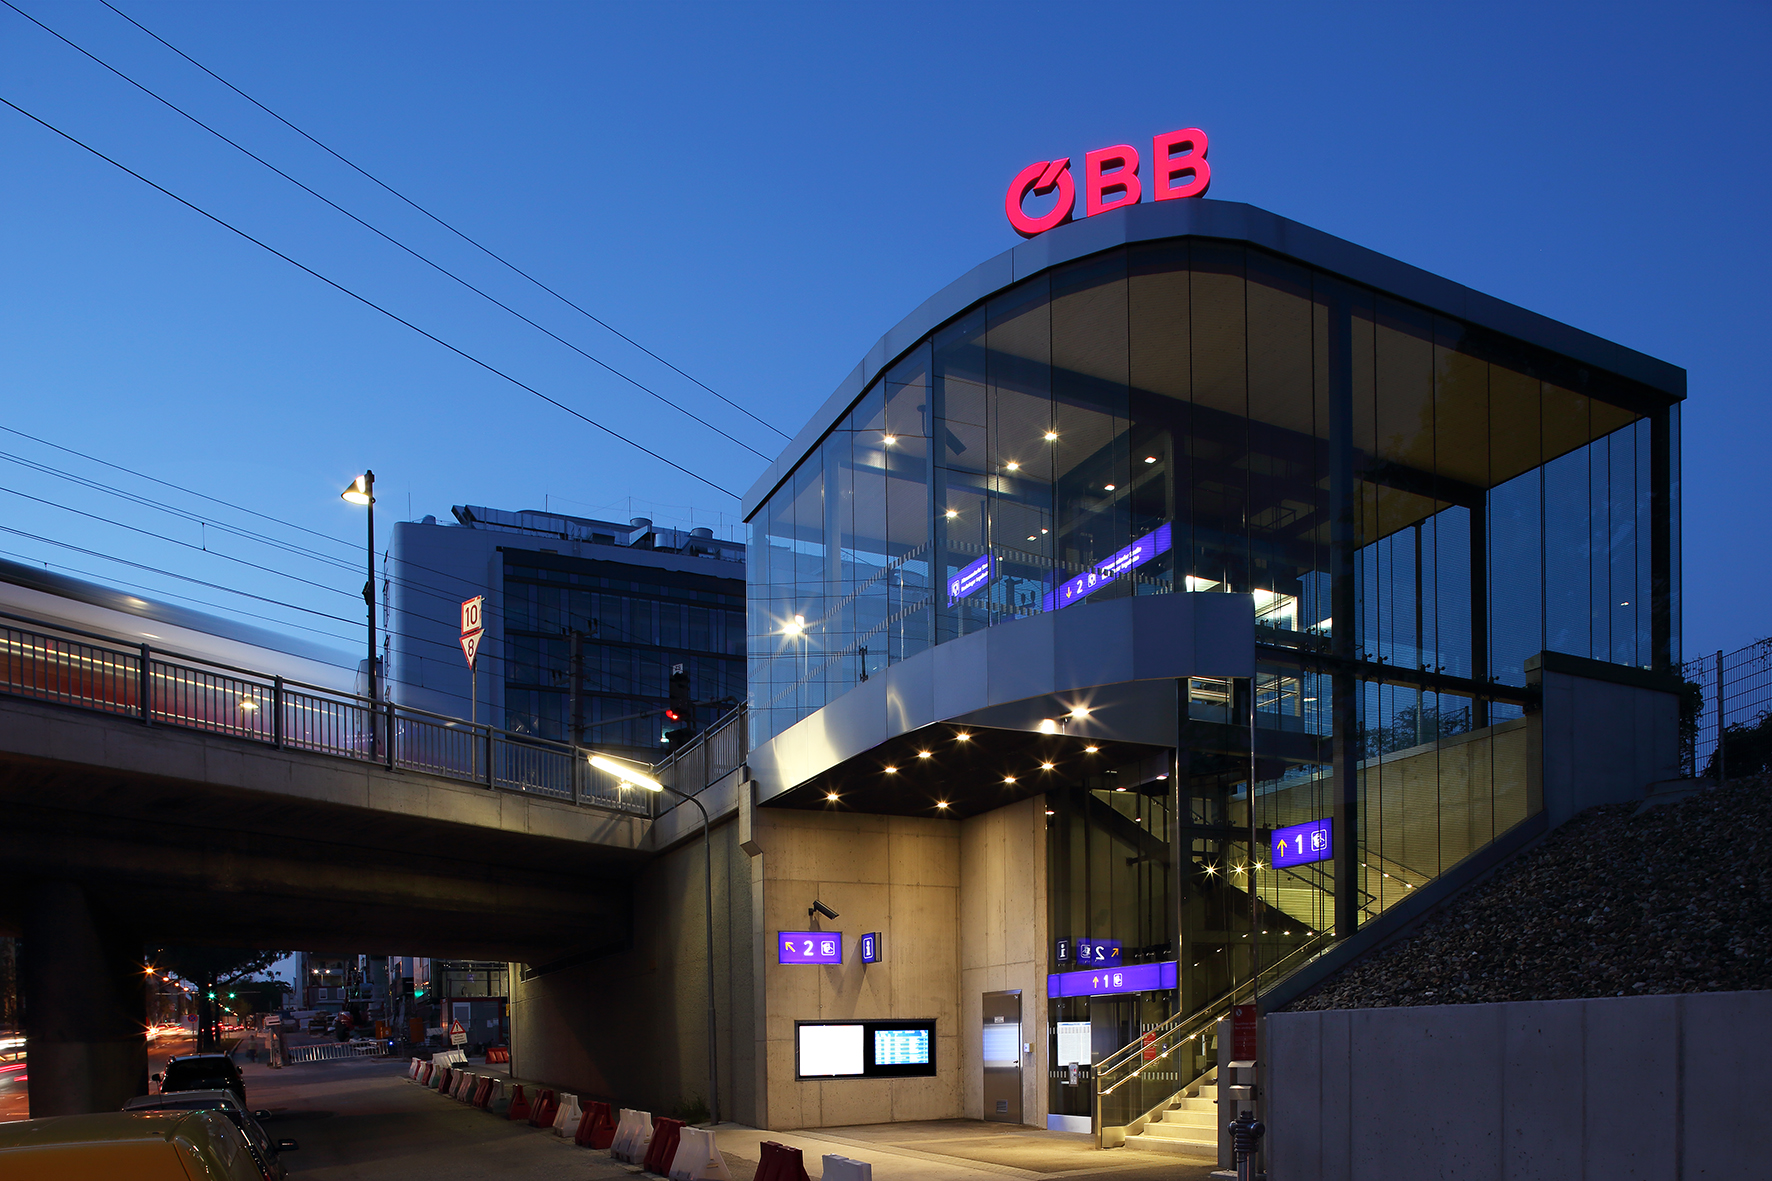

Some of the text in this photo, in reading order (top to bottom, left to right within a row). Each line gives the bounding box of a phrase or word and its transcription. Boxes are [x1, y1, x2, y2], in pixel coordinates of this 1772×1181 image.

[1005, 127, 1211, 234] ÖBB
[1076, 579, 1083, 594] 2
[465, 605, 477, 627] 10
[468, 639, 474, 657] 8
[1295, 834, 1303, 855] 1
[803, 940, 814, 956] 2
[866, 940, 871, 956] i
[1103, 974, 1109, 988] 1
